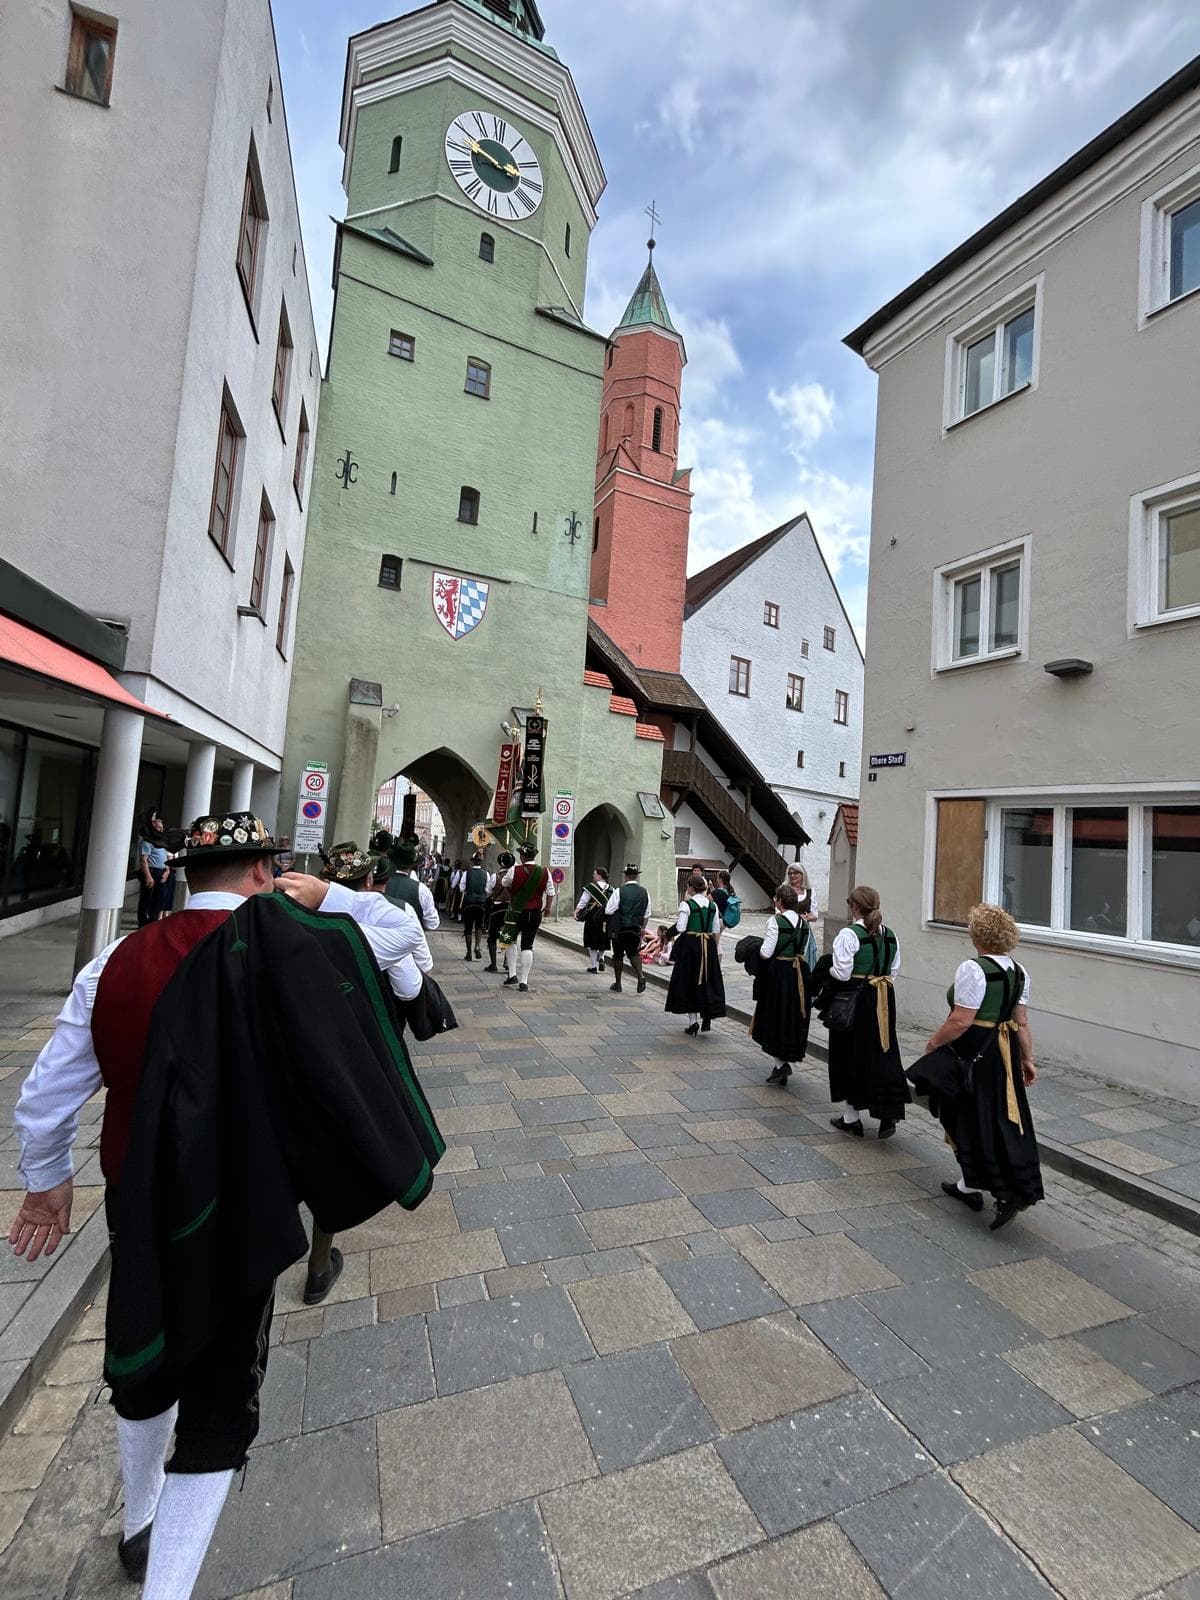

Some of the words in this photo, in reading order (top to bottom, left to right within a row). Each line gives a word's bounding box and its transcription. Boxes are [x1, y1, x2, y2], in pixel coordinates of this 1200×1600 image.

[472, 112, 488, 138] XI
[493, 116, 506, 144] XII
[449, 160, 473, 178] VIII
[518, 161, 539, 169] II
[464, 178, 483, 200] VII
[520, 176, 542, 194] III
[487, 189, 498, 215] VI
[871, 756, 886, 765] Obere
[887, 754, 903, 764] Stadt
[310, 777, 321, 787] 20
[559, 803, 568, 812] 20
